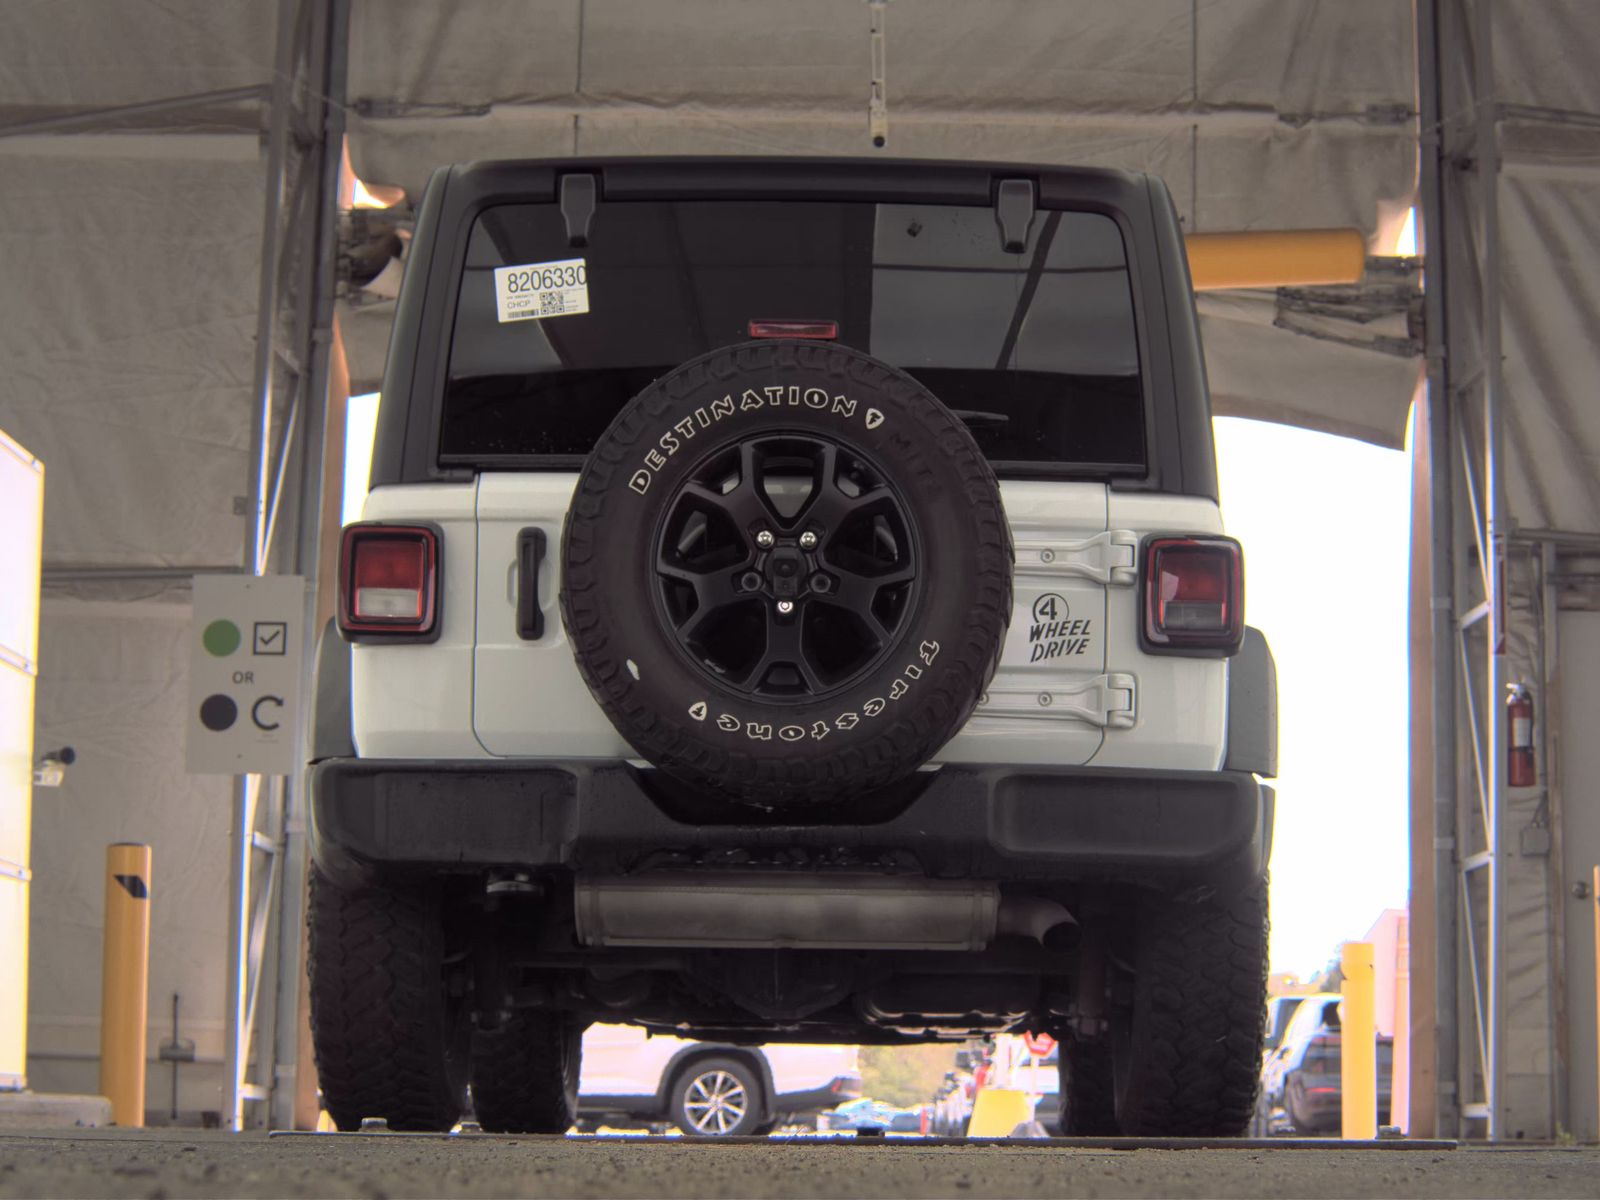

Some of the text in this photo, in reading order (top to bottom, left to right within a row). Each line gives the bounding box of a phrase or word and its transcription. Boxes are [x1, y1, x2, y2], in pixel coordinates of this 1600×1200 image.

[507, 265, 587, 293] 8206330
[628, 386, 857, 495] DESTINATION
[1038, 597, 1058, 621] 4
[1029, 619, 1091, 643] WHEEL
[1030, 638, 1090, 663] DRIVE
[232, 671, 255, 685] OR
